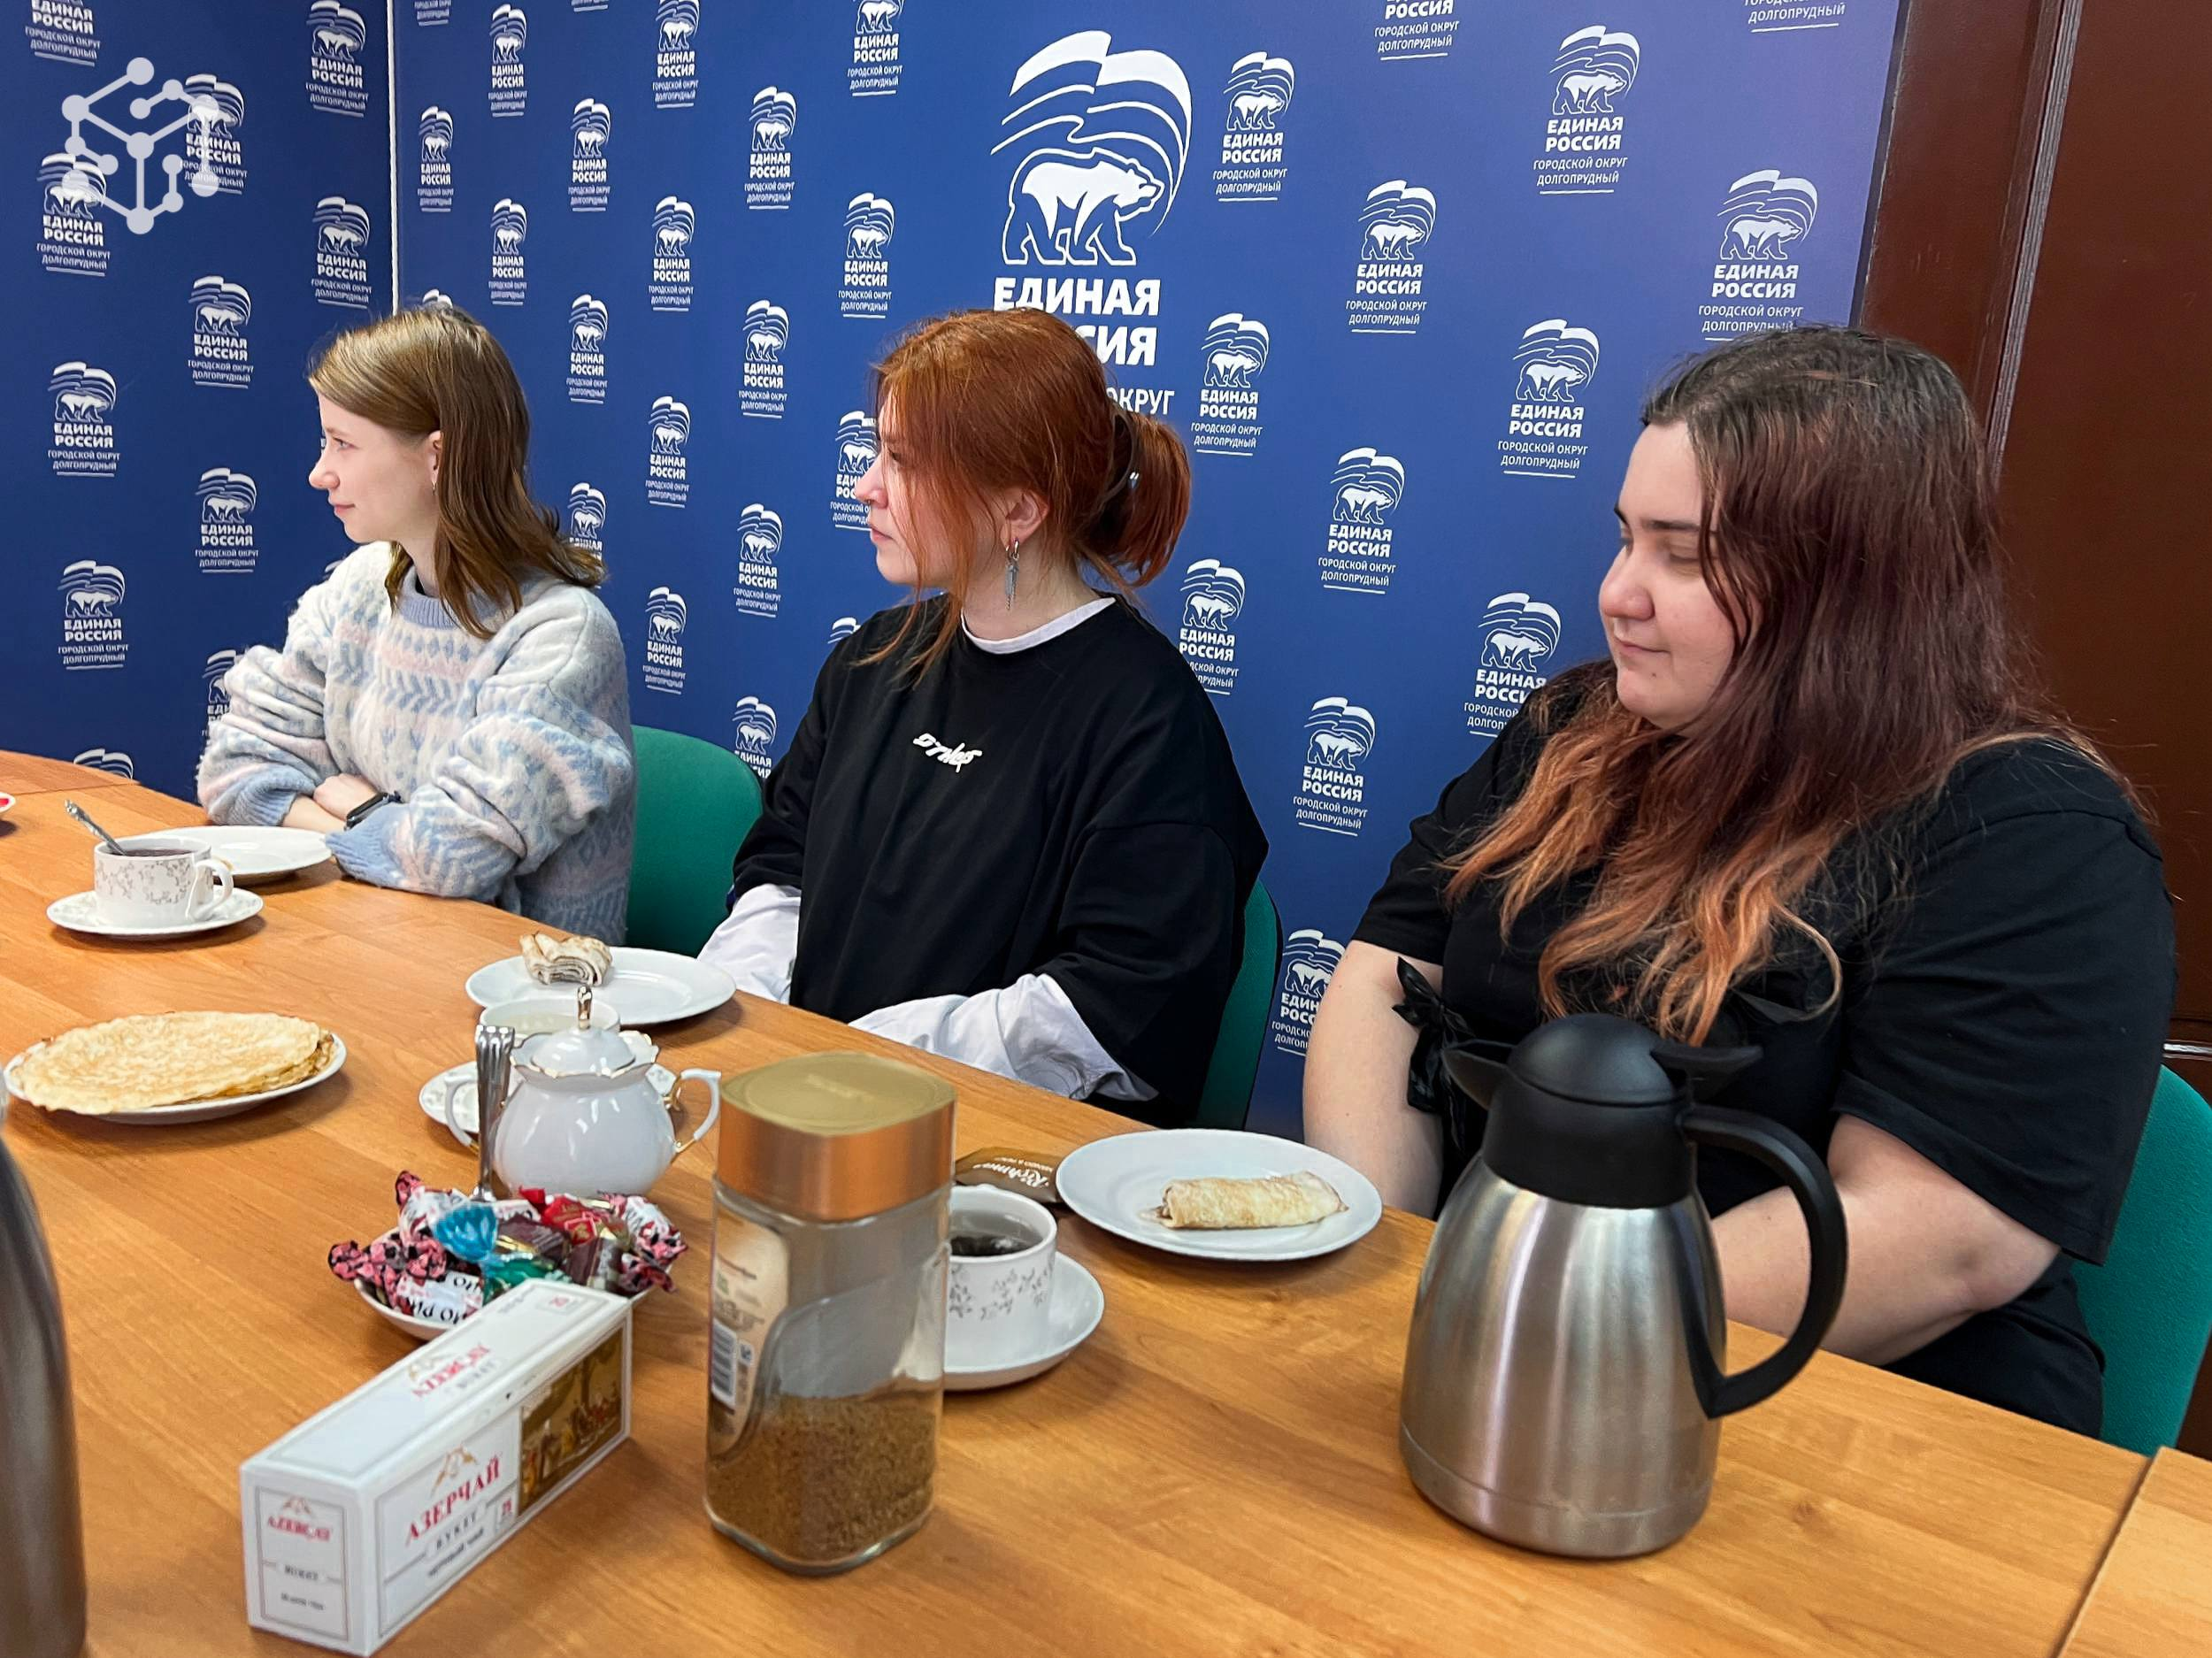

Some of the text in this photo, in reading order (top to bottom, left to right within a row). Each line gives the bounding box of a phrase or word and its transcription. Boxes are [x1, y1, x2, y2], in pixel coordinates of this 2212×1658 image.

[32, 0, 92, 20] ЕДИНАЯ
[1386, 0, 1453, 19] РОССИЯ
[1748, 3, 1846, 24] ДОЛГОПРУДНЫЙ
[33, 12, 93, 35] РОССИЯ
[1375, 21, 1459, 37] ГОРОДСКОЙ ОКРУГ
[854, 34, 899, 50] ЕДИНАЯ
[1378, 35, 1452, 52] ДОЛГОПРУДНЫЙ
[657, 51, 695, 65] ЕДИНАЯ
[854, 48, 898, 63] РОССИЯ
[311, 57, 362, 76] ЕДИНАЯ
[492, 64, 523, 77] ЕДИНАЯ
[657, 64, 695, 78] РОССИЯ
[848, 65, 902, 77] ГОРОДСКОЙ ОКРУГ
[312, 69, 362, 88] РОССИЯ
[492, 76, 524, 88] РОССИЯ
[850, 76, 898, 89] ДОЛГОПРУДНЫЙ
[1548, 117, 1623, 135] ЕДИНАЯ
[1224, 133, 1283, 149] ЕДИНАЯ
[1546, 134, 1621, 152] РОССИЯ
[750, 153, 790, 165] ЕДИНАЯ
[1222, 149, 1282, 164] РОССИЯ
[1533, 157, 1628, 170] ГОРОДСКОЙ ОКРУГ
[421, 164, 450, 174] ЕДИНАЯ
[572, 159, 606, 171] ЕДИНАЯ
[750, 165, 790, 178] РОССИЯ
[421, 174, 450, 185] РОССИЯ
[572, 171, 606, 182] РОССИЯ
[1213, 169, 1287, 180] ГОРОДСКОЙ ОКРУГ
[1537, 171, 1619, 187] ДОЛГОПРУДНЫЙ
[745, 181, 795, 192] ГОРОДСКОЙ ОКРУГ
[1216, 180, 1280, 195] ДОЛГОПРУДНЫЙ
[747, 192, 791, 203] ДОЛГОПРУДНЫЙ
[43, 215, 103, 234] ЕДИНАЯ
[44, 227, 104, 246] РОССИЯ
[317, 253, 366, 270] ЕДИНАЯ
[493, 256, 524, 266] ЕДИНАЯ
[654, 258, 689, 270] ЕДИНАЯ
[845, 261, 887, 273] ЕДИНАЯ
[318, 265, 366, 282] РОССИЯ
[493, 267, 524, 278] РОССИЯ
[654, 271, 689, 281] РОССИЯ
[1357, 264, 1423, 279] ЕДИНАЯ
[1714, 265, 1799, 280] ЕДИНАЯ
[845, 274, 887, 287] РОССИЯ
[1356, 280, 1421, 294] РОССИЯ
[839, 290, 872, 300] ГОРОДСКОЙ
[993, 277, 1161, 316] ЕДИНАЯ
[1712, 283, 1796, 298] РОССИЯ
[841, 302, 887, 311] ДОЛГОПРУДНЫЙ
[1346, 299, 1427, 311] ГОРОДСКОЙ ОКРУГ
[1699, 304, 1803, 318] ГОРОДСКОЙ ОКРУГ
[1349, 314, 1419, 326] ДОЛГОПРУДНЫЙ
[194, 334, 247, 349] ЕДИНАЯ
[195, 346, 247, 361] РОССИЯ
[571, 352, 603, 365] ЕДИНАЯ
[571, 364, 603, 376] РОССИЯ
[744, 363, 783, 375] ЕДИНАЯ
[744, 375, 783, 388] РОССИЯ
[1201, 389, 1258, 403] ЕДИНАЯ
[1200, 404, 1256, 419] РОССИЯ
[1511, 404, 1584, 420] ЕДИНАЯ
[54, 423, 112, 435] ЕДИНАЯ
[1191, 423, 1263, 435] ГОРОДСКОЙ ОКРУГ
[1509, 420, 1582, 438] РОССИЯ
[55, 435, 113, 448] РОССИЯ
[1194, 435, 1256, 448] ДОЛГОПРУДНЫЙ
[1498, 441, 1588, 457] ГОРОДСКОЙ ОКРУГ
[650, 455, 685, 467] ЕДИНАЯ
[1501, 456, 1579, 469] ДОЛГОПРУДНЫЙ
[650, 465, 686, 480] РОССИЯ
[836, 474, 860, 487] ЕДИ
[201, 525, 252, 534] ЕДИНАЯ
[1329, 525, 1392, 541] ЕДИНАЯ
[202, 536, 253, 546] РОССИЯ
[1328, 539, 1390, 557] РОССИЯ
[739, 562, 777, 577] ЕДИНАЯ
[1318, 557, 1395, 573] ГОРОДСКОЙ ОКРУГ
[739, 573, 777, 589] РОССИЯ
[1321, 571, 1388, 586] ДОЛГОПРУДНЫЙ
[65, 618, 121, 631] ЕДИНАЯ
[65, 630, 121, 641] РОССИЯ
[1180, 628, 1235, 647] ЕДИНАЯ
[648, 641, 682, 656] ЕДИНАЯ
[1179, 641, 1234, 662] РОССИЯ
[648, 652, 682, 668] РОССИЯ
[1216, 665, 1239, 677] ОКРУГ
[1197, 675, 1233, 688] ПРУДНЫЙ
[1476, 669, 1547, 689] ЕДИНАЯ
[1475, 684, 1530, 703] РОССИ
[1303, 766, 1363, 787] ЕДИНАЯ
[1302, 779, 1362, 802] РОССИЯ
[1294, 796, 1368, 817] ГОРОДСКОЙ ОКРУГ
[1296, 809, 1361, 829] ДОЛГОПРУДНЫЙ
[1281, 992, 1319, 1011] ЕДИН
[1280, 1005, 1316, 1025] РОСС
[405, 1454, 501, 1547] АЗЕРЧАЙ
